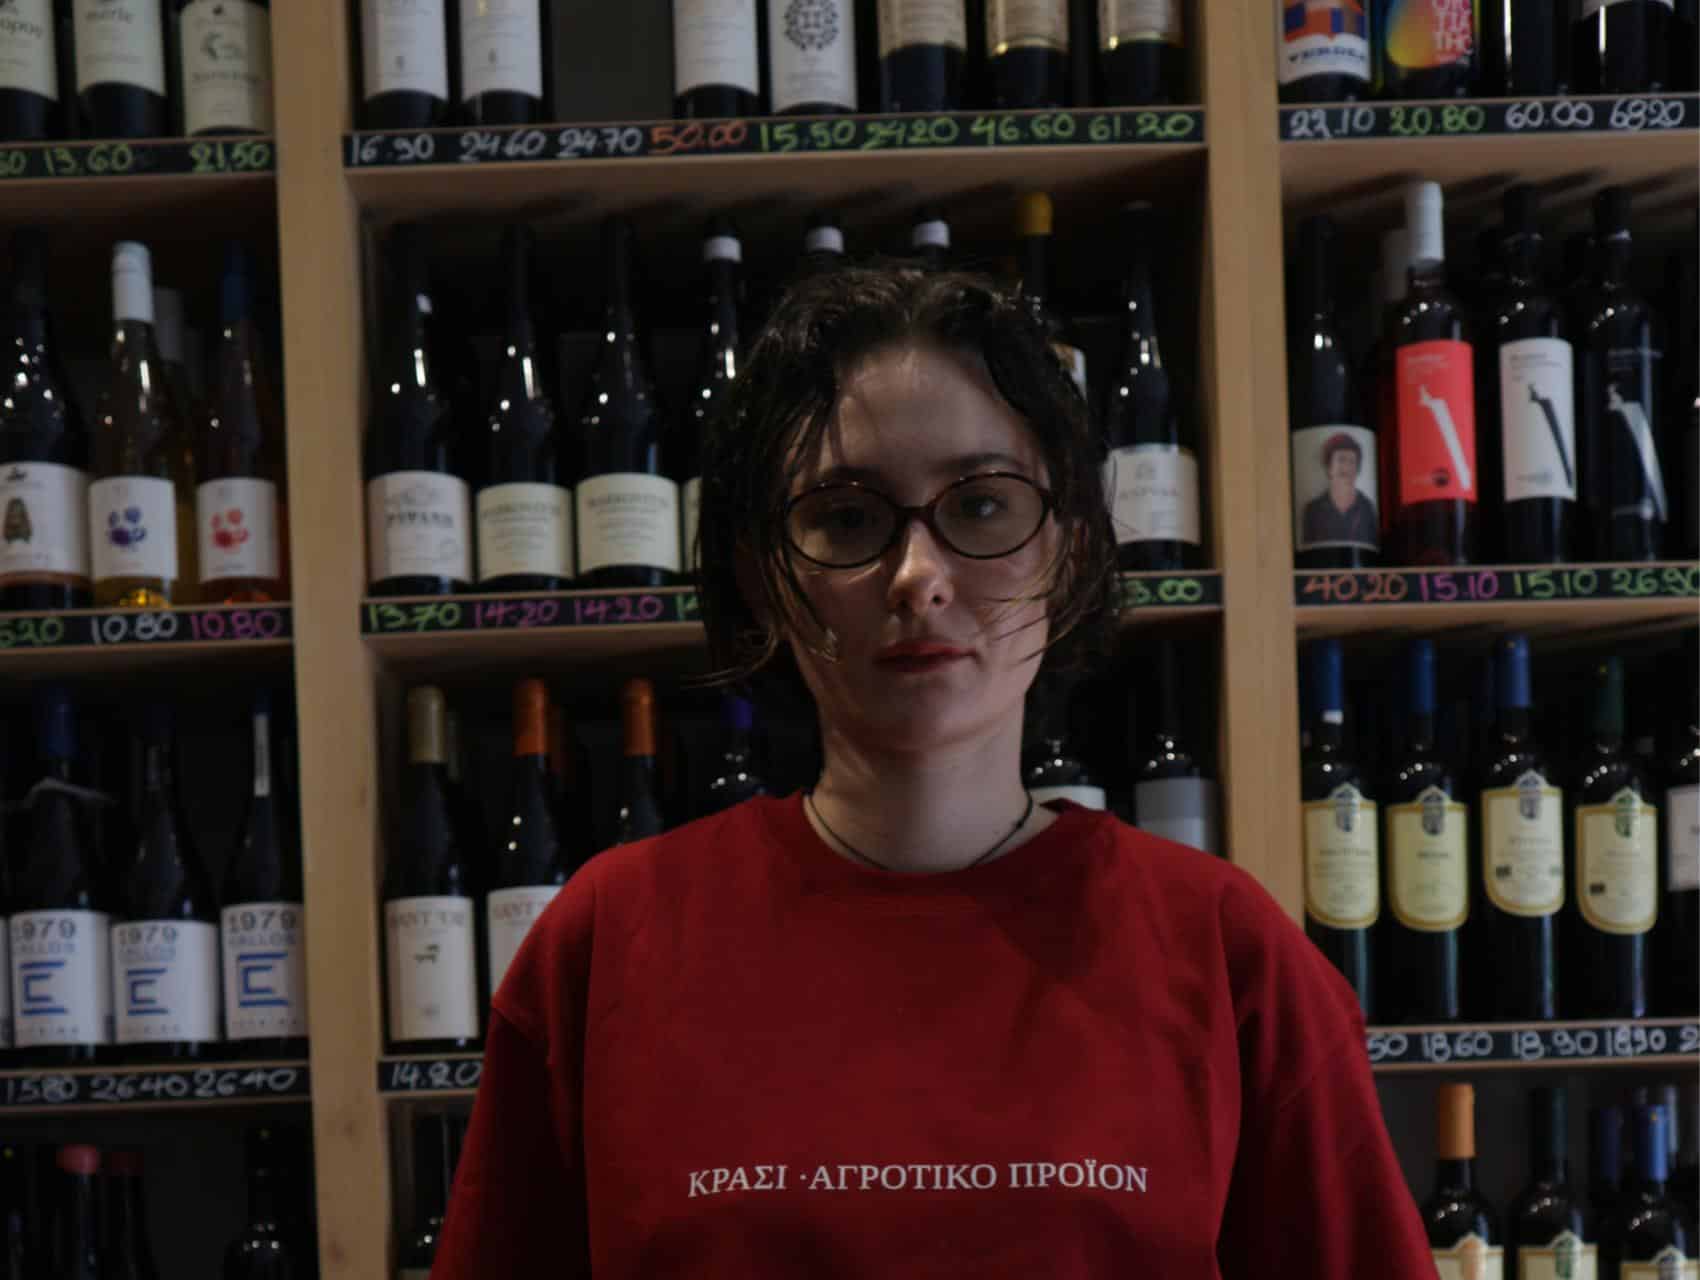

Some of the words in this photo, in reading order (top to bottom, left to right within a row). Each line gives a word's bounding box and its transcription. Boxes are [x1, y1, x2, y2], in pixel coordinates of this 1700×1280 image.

[1390, 105, 1487, 134] 20.80
[1504, 99, 1594, 129] 60.00
[351, 134, 435, 164] 16.90
[649, 120, 748, 153] 50.00
[760, 120, 857, 152] 15.50
[970, 112, 1076, 147] 46.60
[1088, 111, 1196, 141] 61.20
[43, 143, 134, 177] 13.60
[189, 141, 271, 172] 21.50
[1418, 570, 1500, 600] 15.10
[1512, 569, 1598, 598] 15.10
[91, 612, 179, 644] 10.80
[189, 609, 282, 641] 10.80
[1511, 1028, 1598, 1060] 18.90
[687, 1164, 788, 1198] ΚΡΑΣΙ
[1008, 1159, 1148, 1193] ΠΡΟΪΟΝ
